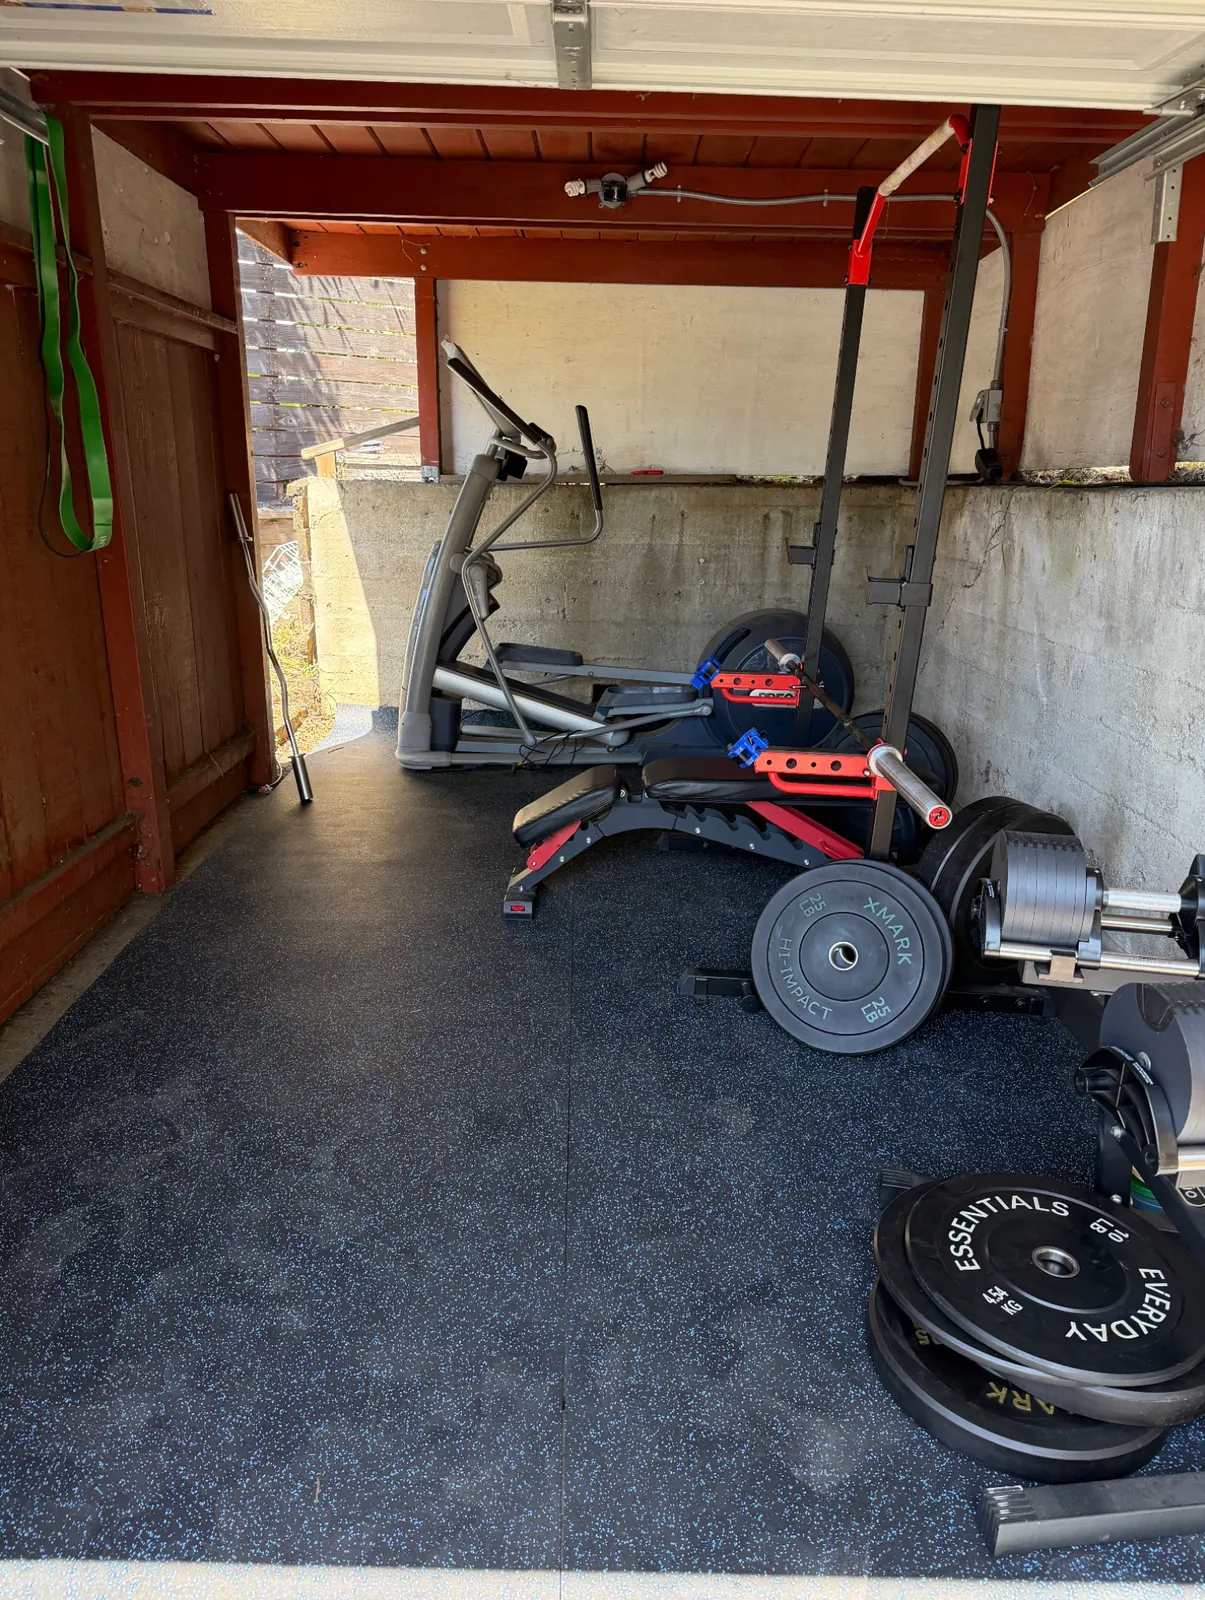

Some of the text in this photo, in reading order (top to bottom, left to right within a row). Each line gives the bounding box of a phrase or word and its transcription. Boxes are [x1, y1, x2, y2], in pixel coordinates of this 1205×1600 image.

[799, 900, 816, 919] LB
[808, 893, 827, 912] 25
[863, 897, 912, 965] XMARK
[778, 938, 833, 1020] HI-IMPACT
[860, 1006, 879, 1023] LB
[871, 997, 891, 1018] 25
[949, 1195, 1070, 1271] ESSENTIALS
[1089, 1217, 1114, 1234] LB
[1107, 1228, 1130, 1243] 10
[982, 1286, 1008, 1305] 4.54
[1065, 1267, 1171, 1342] EVERYDAY
[1001, 1299, 1024, 1316] KG
[986, 1382, 1055, 1415] ARK
